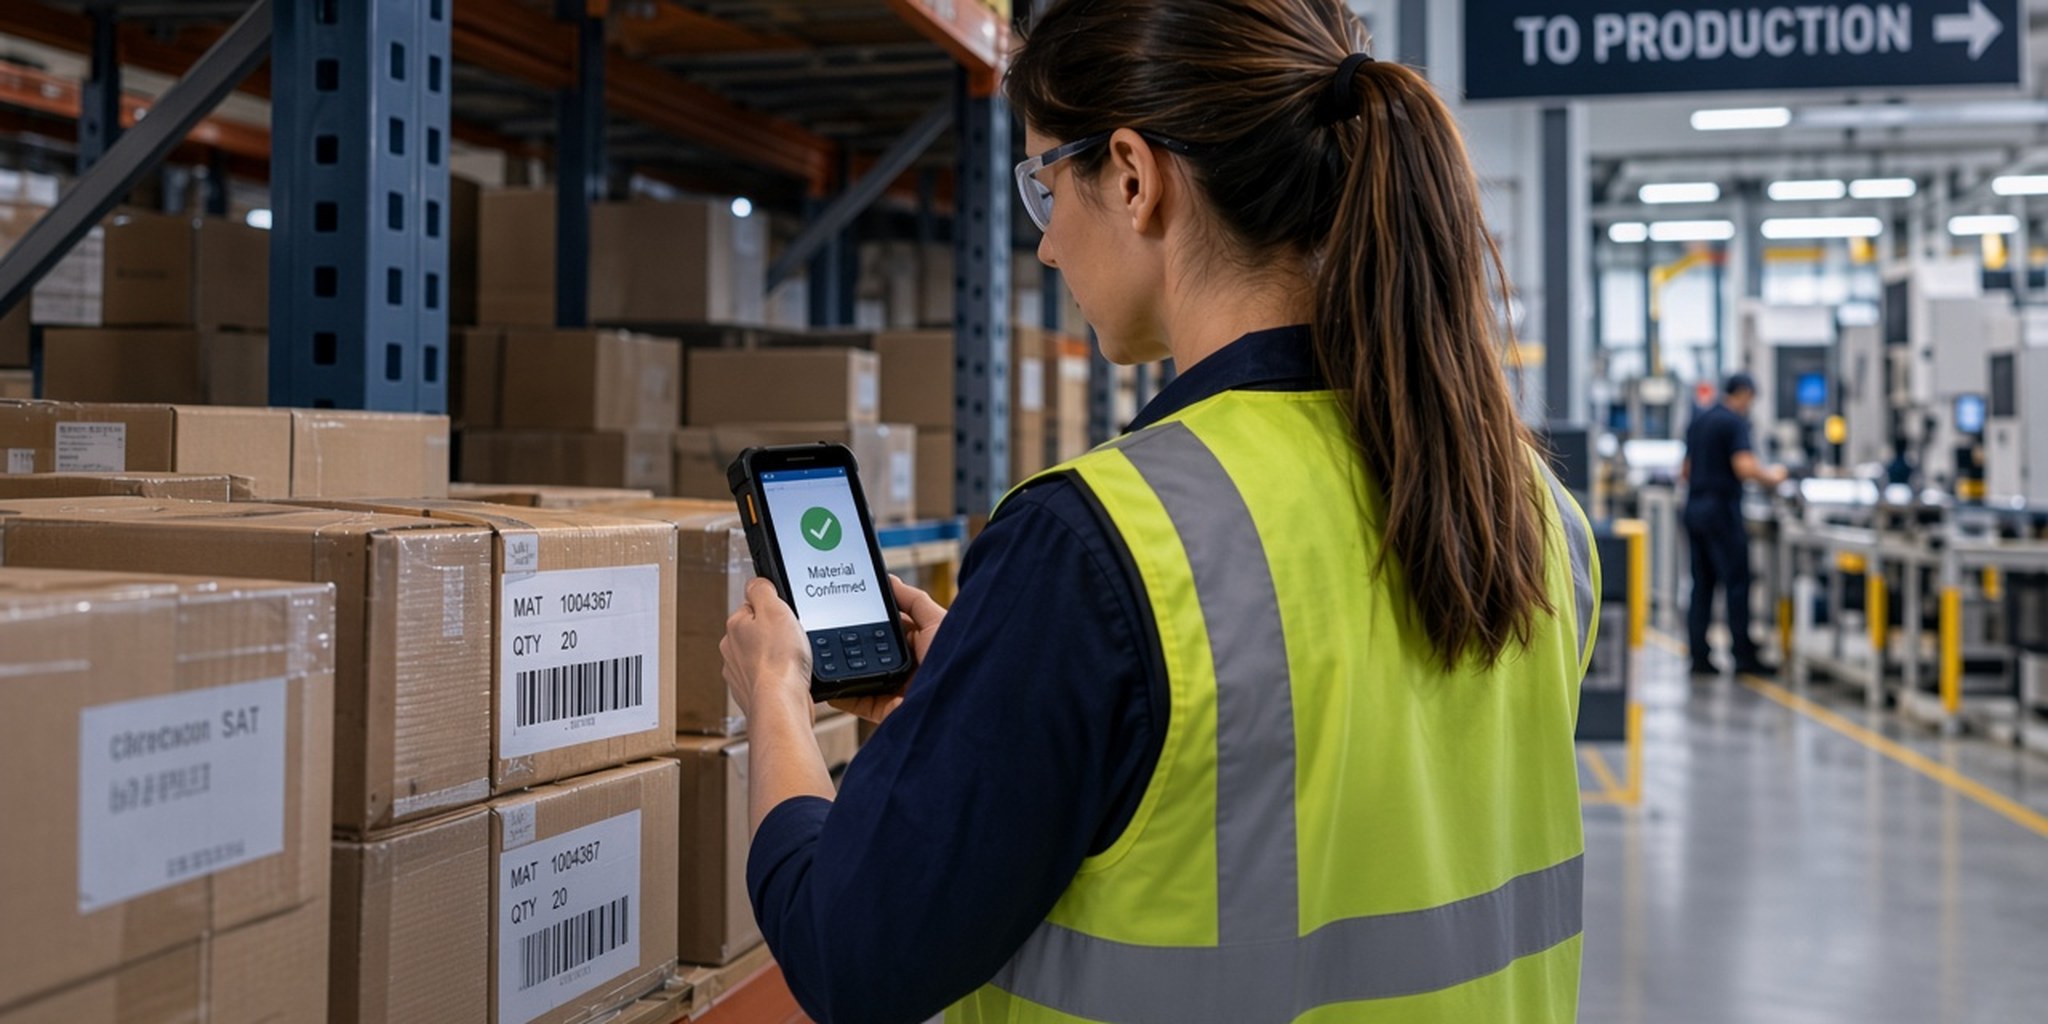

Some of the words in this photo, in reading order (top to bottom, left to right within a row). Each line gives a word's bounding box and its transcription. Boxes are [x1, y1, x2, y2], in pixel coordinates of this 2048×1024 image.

[1515, 14, 1581, 66] TO
[1594, 4, 1911, 63] PRODUCTION
[808, 563, 855, 579] Material
[805, 580, 866, 598] Confirmed
[513, 596, 543, 618] MAT
[561, 590, 613, 614] 1004367
[513, 634, 542, 656] QTY
[561, 630, 578, 650] 20
[222, 705, 259, 739] SAT
[510, 861, 538, 889] MAT
[511, 897, 537, 925] QTY
[552, 887, 568, 910] 20
